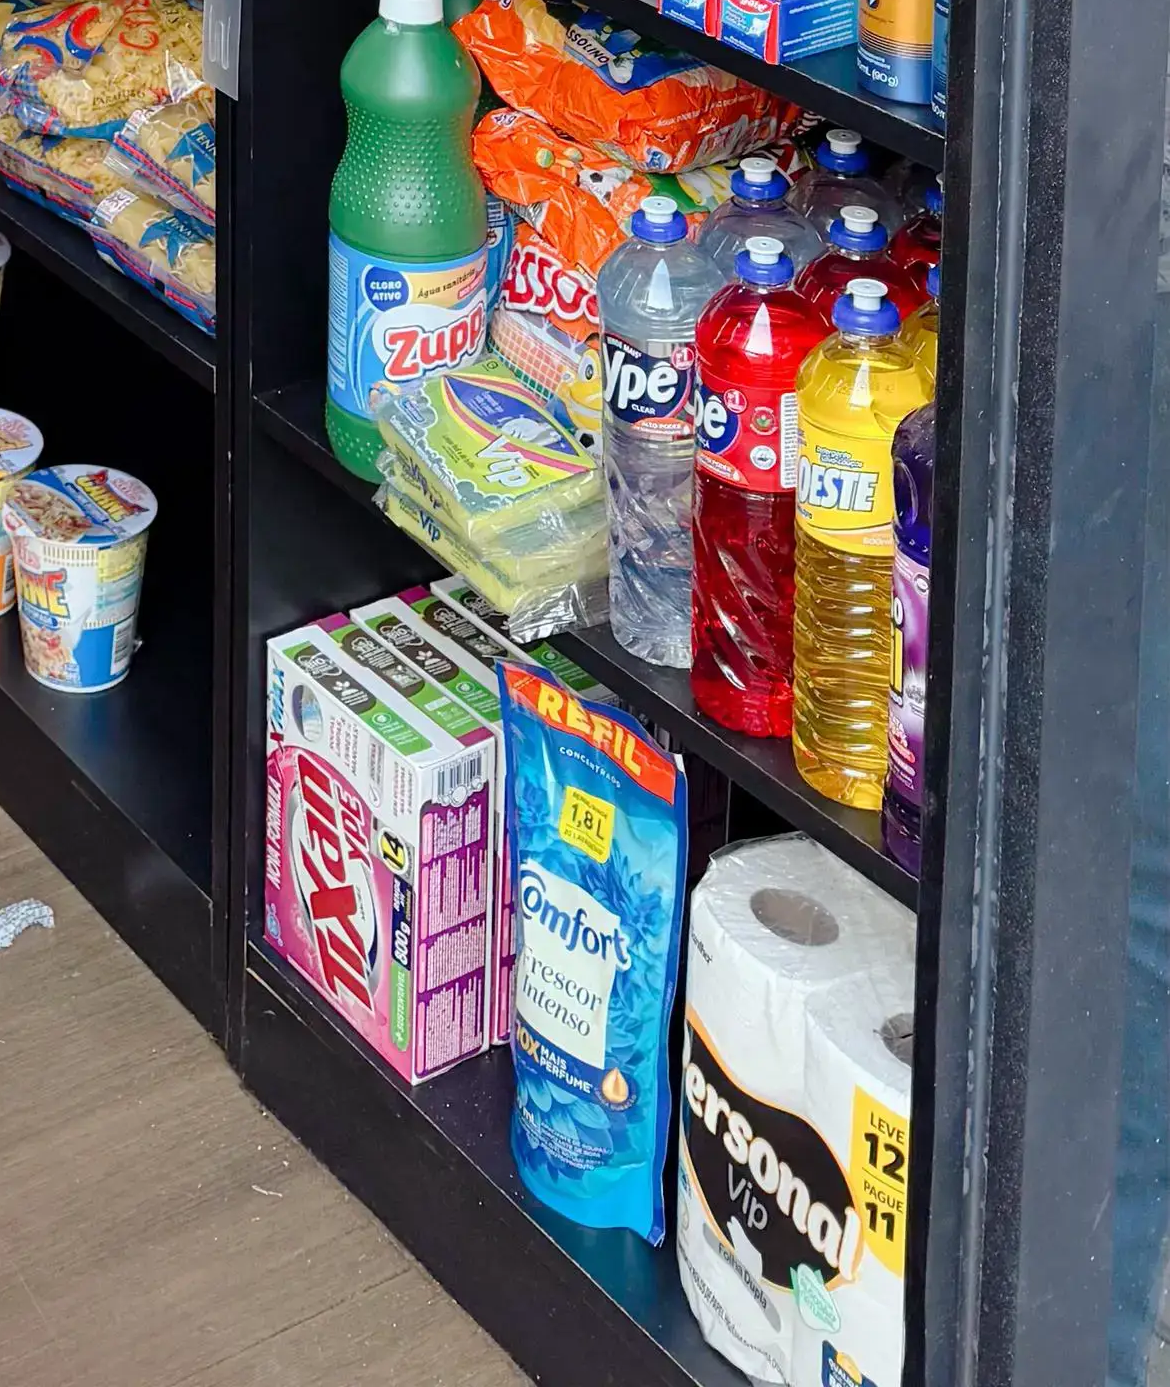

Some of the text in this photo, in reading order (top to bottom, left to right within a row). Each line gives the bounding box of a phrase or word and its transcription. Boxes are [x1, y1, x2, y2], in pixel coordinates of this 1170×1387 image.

[370, 280, 402, 290] CLORO
[372, 291, 402, 301] ATIVO
[417, 268, 476, 299] Água sanitária
[385, 301, 486, 381] Zupp
[631, 403, 656, 415] CLEAR
[476, 435, 531, 488] Vip
[798, 454, 879, 513] OESTE
[419, 510, 441, 542] Vip
[537, 682, 642, 777] REFIL
[559, 746, 622, 789] CONCENTRADO
[571, 803, 604, 840] 1,8 L
[265, 849, 283, 891] NOVA
[380, 832, 403, 870] 14
[520, 869, 628, 965] Comfort
[394, 924, 409, 964] 800g
[520, 945, 602, 1012] Frescor
[521, 973, 591, 1037] Intenso
[539, 1044, 568, 1071] MAIS
[539, 1056, 592, 1095] PERFUME
[869, 1109, 906, 1145] LEVE
[684, 1027, 863, 1283] ersonal
[863, 1132, 906, 1185] 12
[726, 1163, 769, 1231] Vip
[862, 1179, 904, 1215] PAGUE
[864, 1201, 896, 1243] 11
[717, 1242, 768, 1310] Folha Dupla
